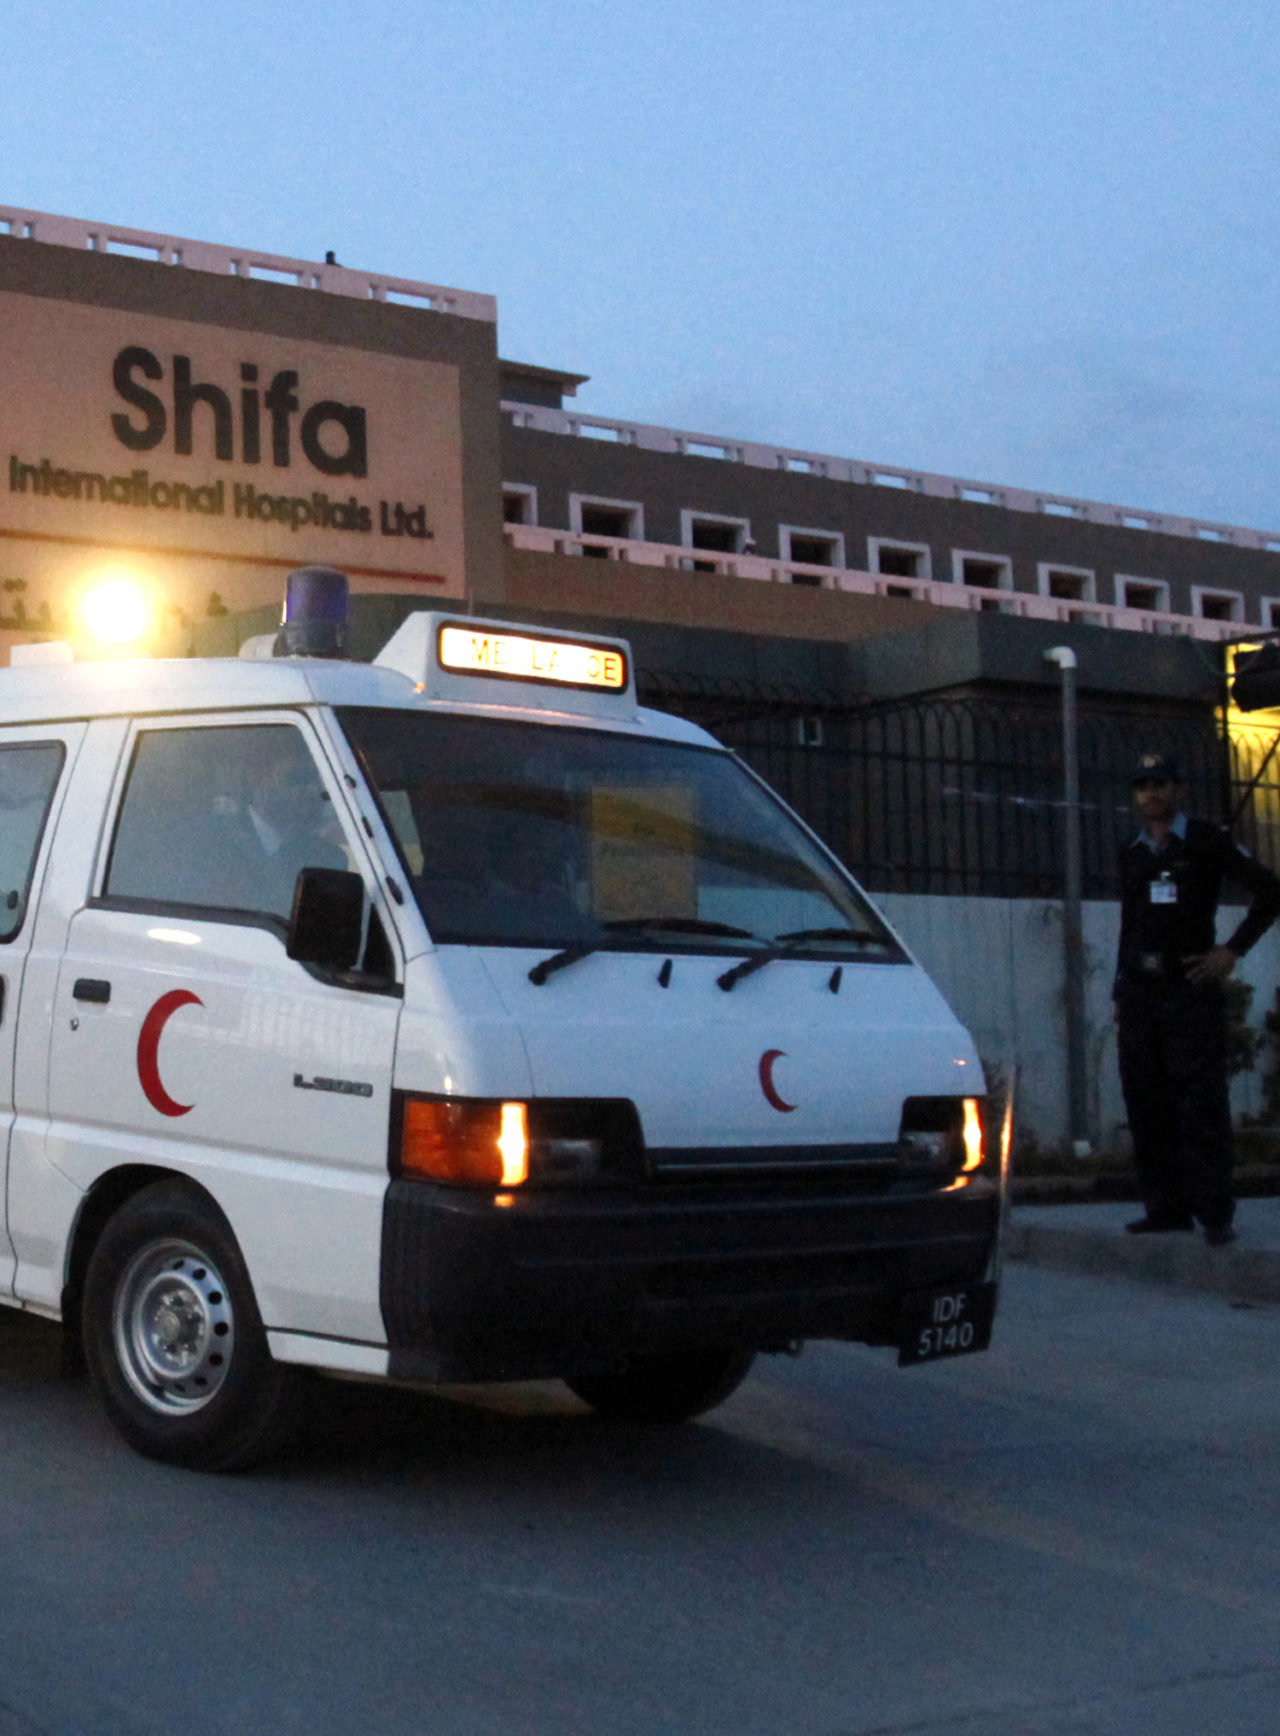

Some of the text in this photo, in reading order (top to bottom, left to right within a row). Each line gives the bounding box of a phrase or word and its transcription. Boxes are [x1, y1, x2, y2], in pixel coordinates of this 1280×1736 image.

[111, 345, 368, 478] Shifa
[9, 454, 435, 539] International Hospitals Ltd.
[933, 1293, 967, 1322] IDF
[917, 1322, 974, 1355] 5140
